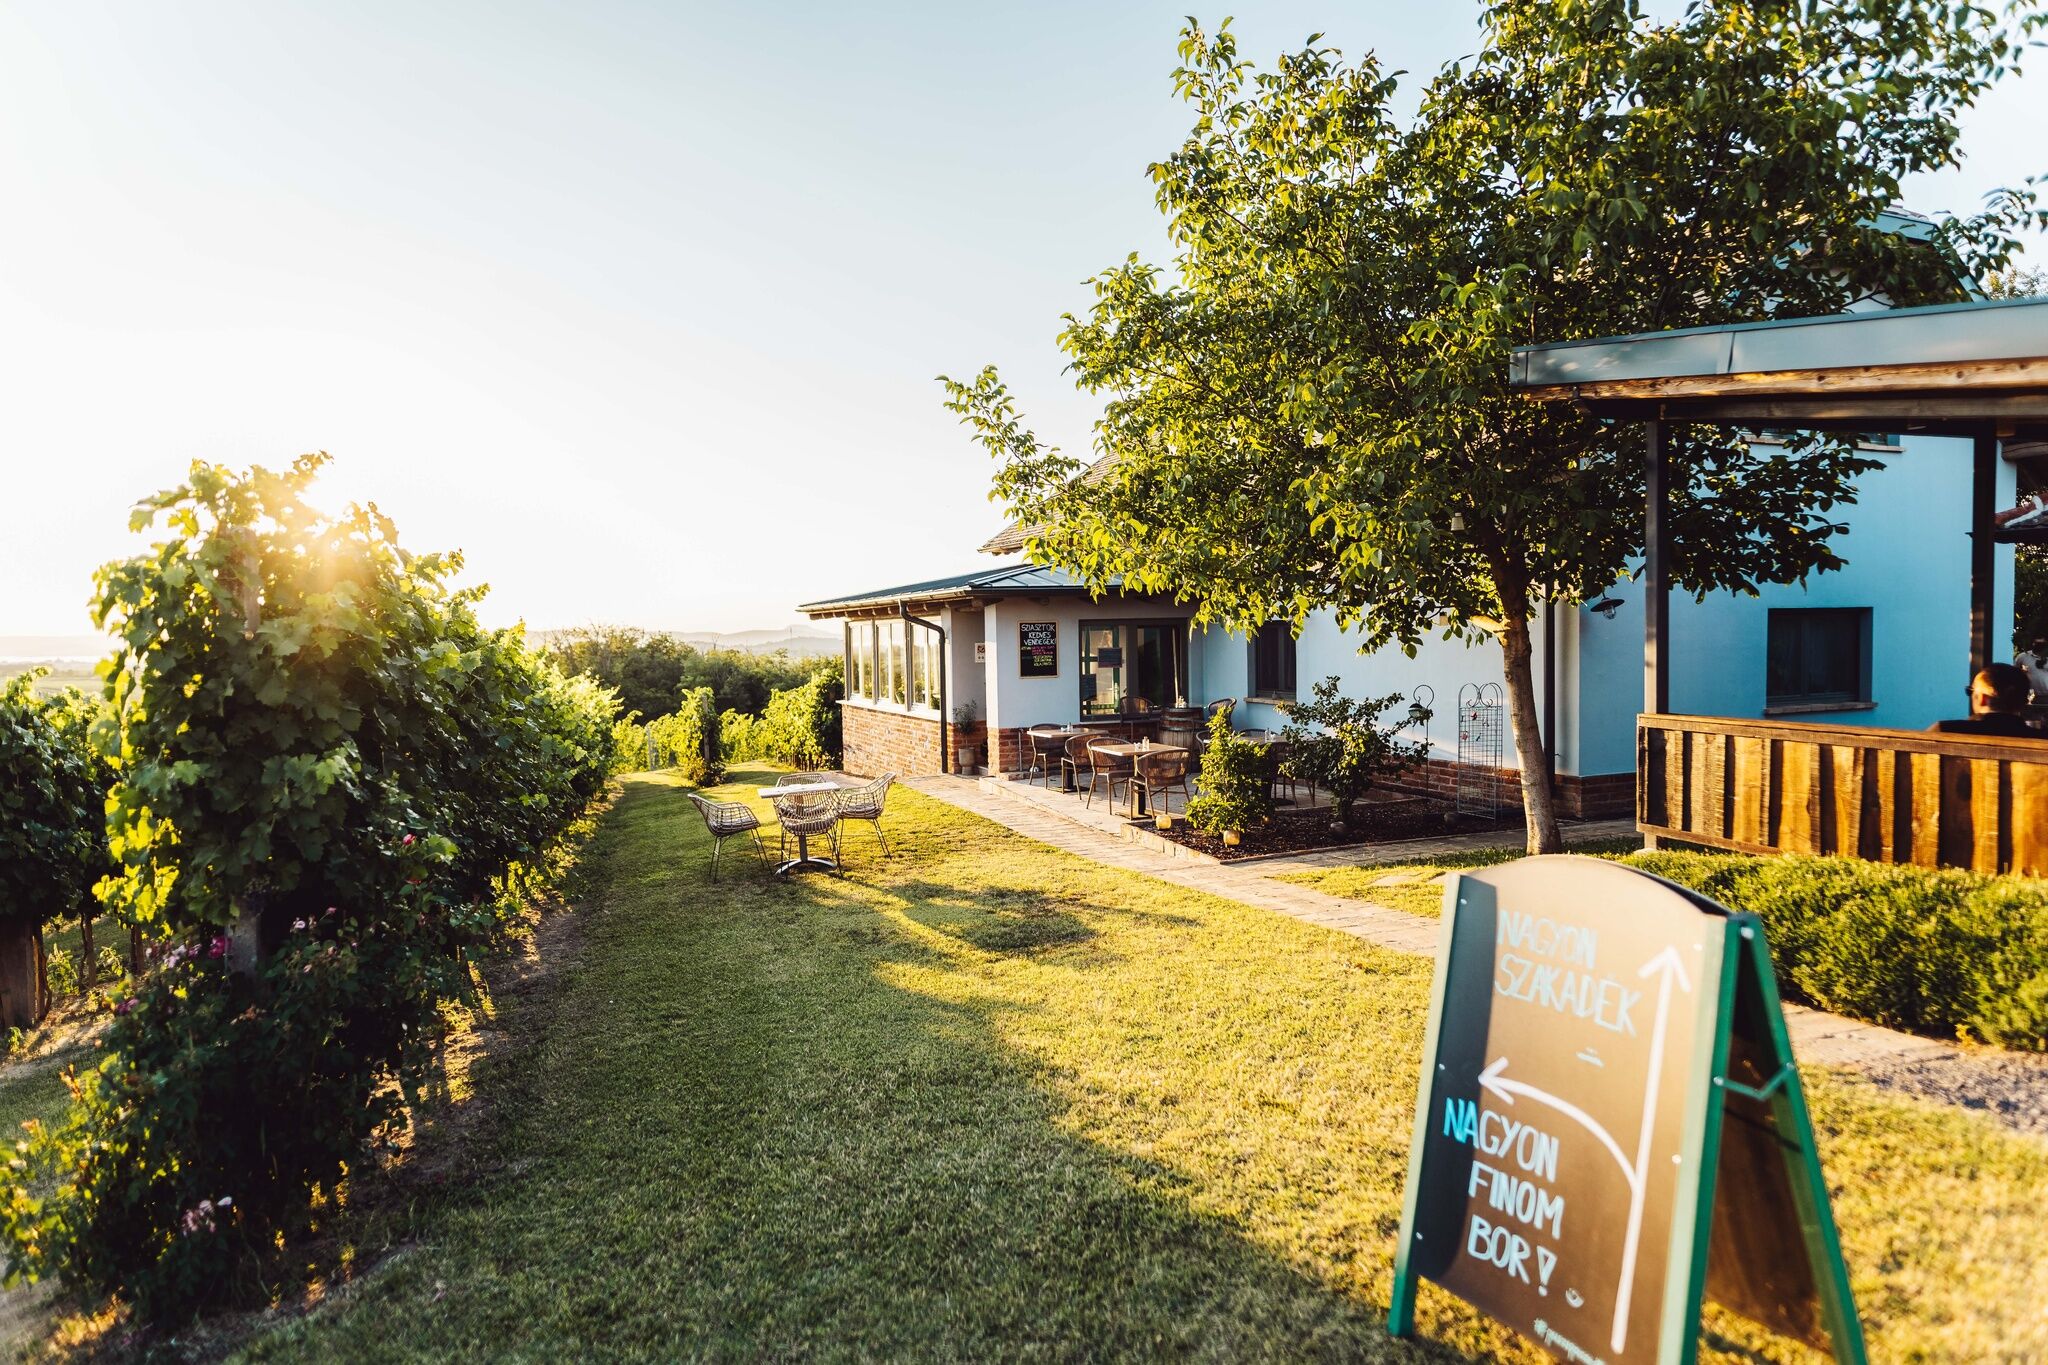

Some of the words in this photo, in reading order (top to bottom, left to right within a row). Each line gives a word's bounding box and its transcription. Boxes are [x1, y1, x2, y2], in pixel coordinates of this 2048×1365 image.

[1021, 624, 1055, 632] SZIASZTOK
[1496, 909, 1598, 970] NAGYON
[1442, 1096, 1560, 1184] NAGYON
[1467, 1160, 1565, 1241] FINOM
